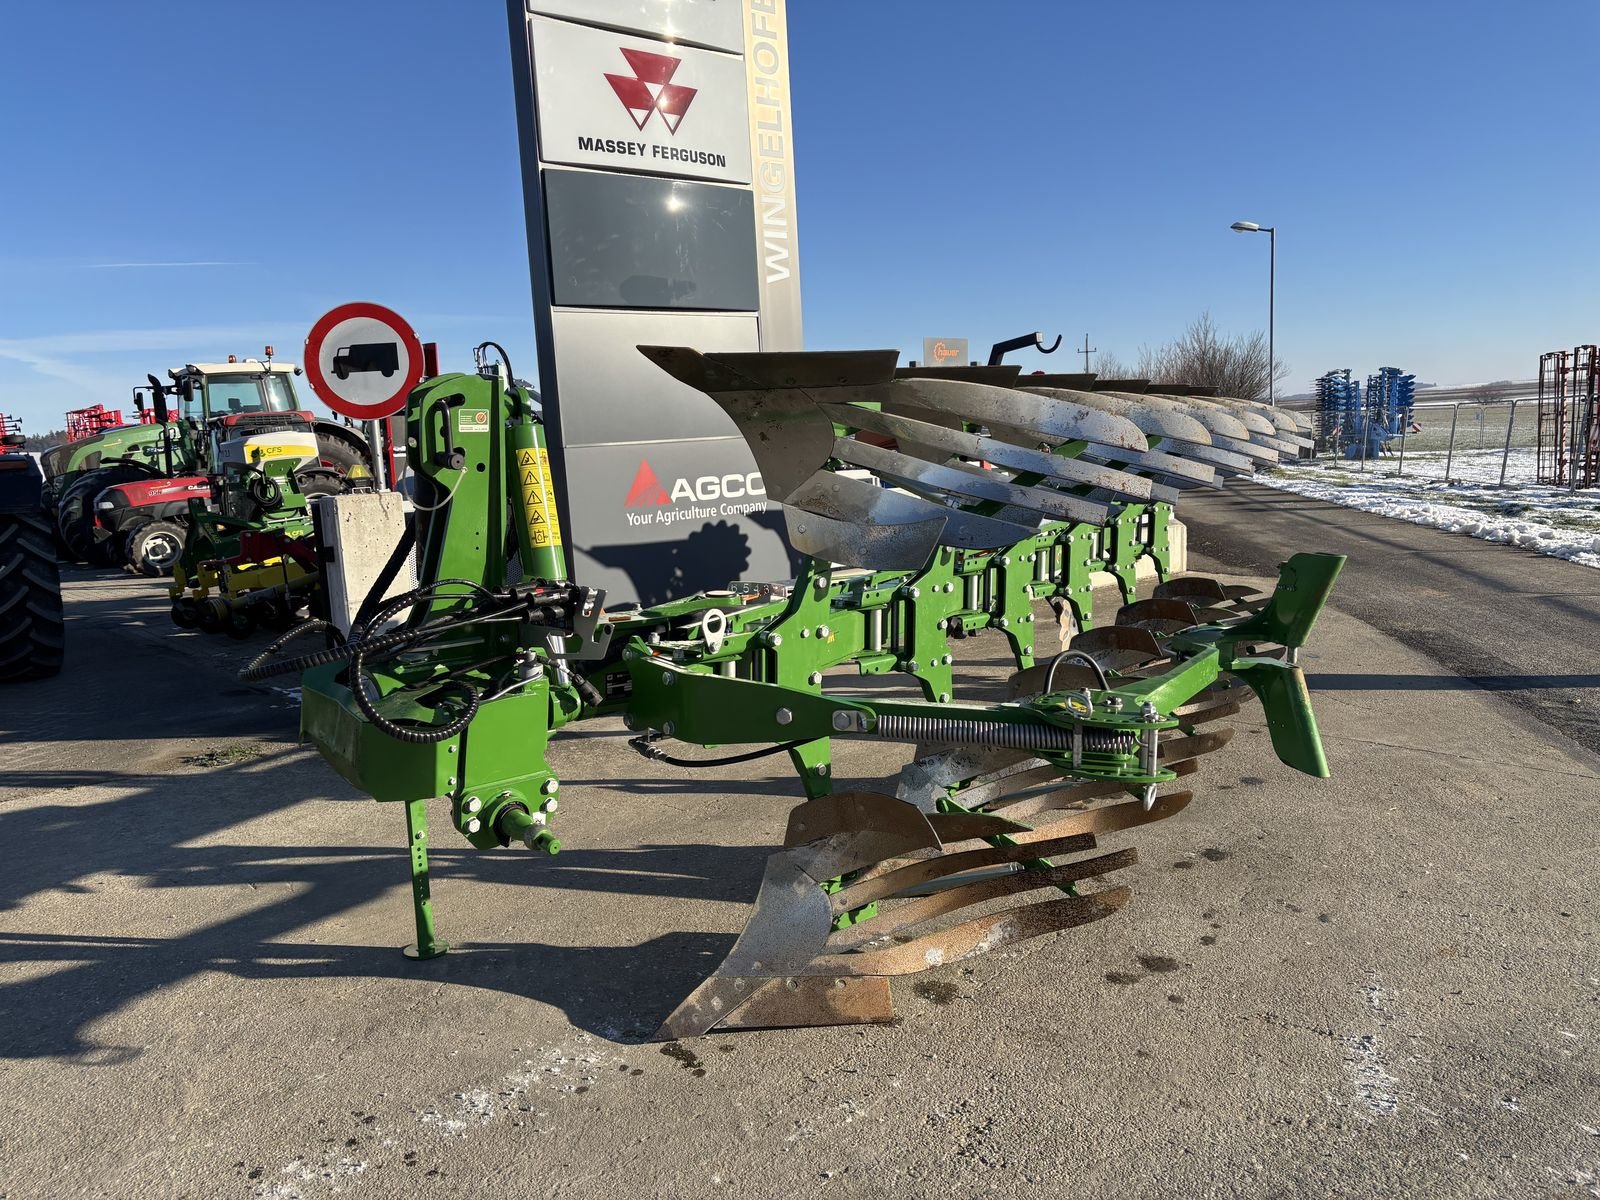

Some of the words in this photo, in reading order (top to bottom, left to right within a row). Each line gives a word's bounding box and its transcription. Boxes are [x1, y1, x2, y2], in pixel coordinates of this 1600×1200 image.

[578, 136, 646, 157] MASSEY
[652, 145, 726, 168] FERGUSON
[266, 446, 282, 454] CFS
[627, 512, 654, 527] Your
[656, 504, 717, 526] Agriculture
[720, 501, 767, 516] Company
[743, 583, 750, 594] 5
